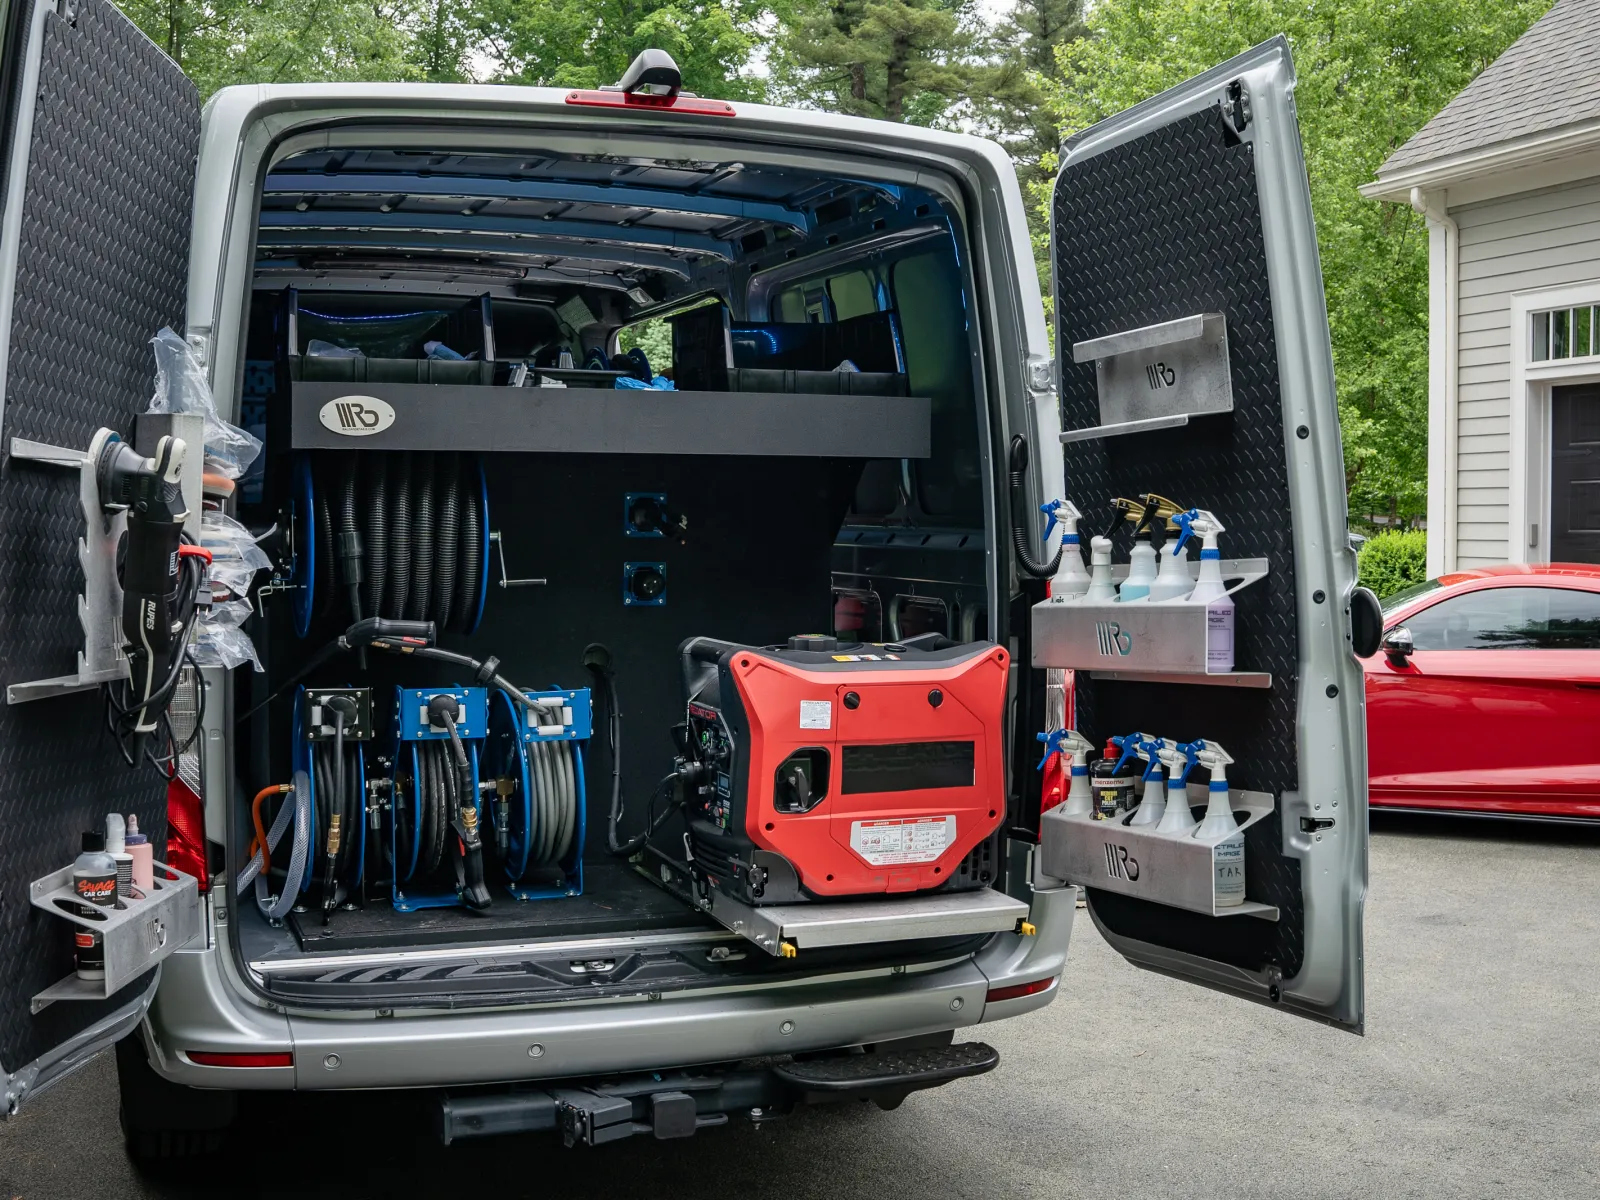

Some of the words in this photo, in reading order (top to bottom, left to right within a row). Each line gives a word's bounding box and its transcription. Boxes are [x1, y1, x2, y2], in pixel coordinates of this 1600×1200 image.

[146, 600, 156, 630] RUPES
[1218, 866, 1242, 878] TAR
[78, 879, 116, 892] SAVAGE
